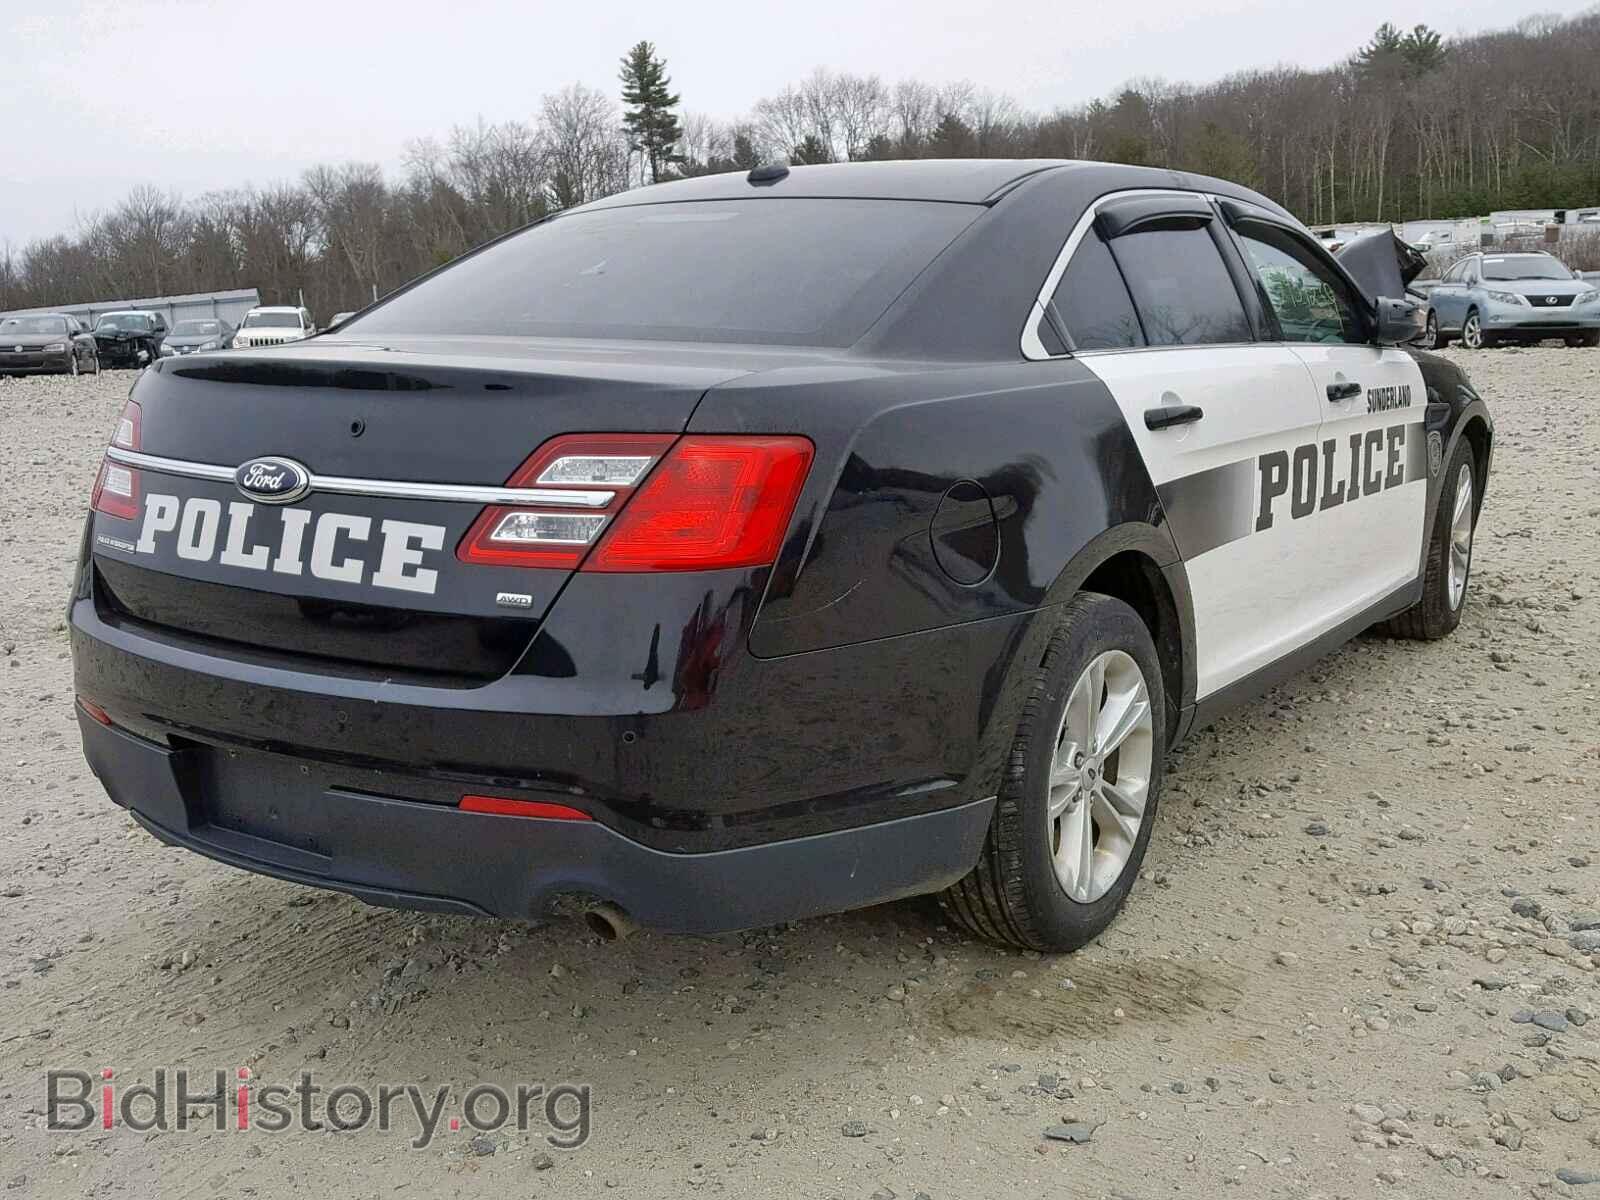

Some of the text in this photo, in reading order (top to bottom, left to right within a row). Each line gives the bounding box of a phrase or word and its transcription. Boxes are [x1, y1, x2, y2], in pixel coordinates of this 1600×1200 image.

[1367, 384, 1411, 414] SUNDERLAND
[244, 463, 284, 491] Ford
[1256, 424, 1405, 532] POLICE
[136, 493, 446, 594] POLICE
[498, 595, 530, 605] AWD
